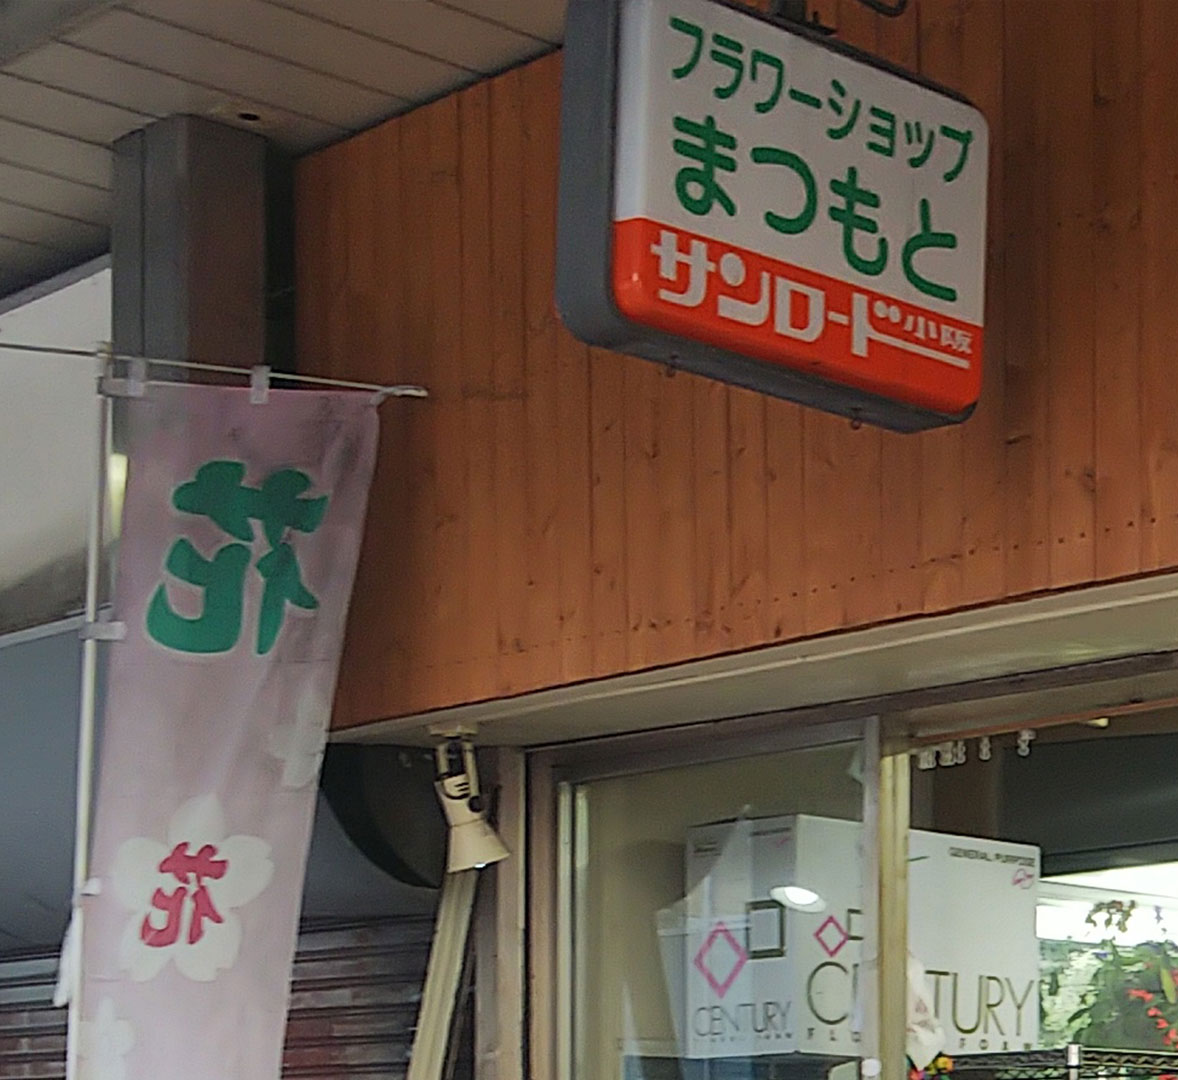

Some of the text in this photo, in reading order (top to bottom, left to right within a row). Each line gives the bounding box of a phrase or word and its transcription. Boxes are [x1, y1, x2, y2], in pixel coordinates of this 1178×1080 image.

[669, 16, 973, 183] フラワーショップ
[673, 115, 957, 302] まつもと
[650, 229, 903, 358] サンロード
[145, 457, 329, 656] 花
[140, 840, 231, 949] 花
